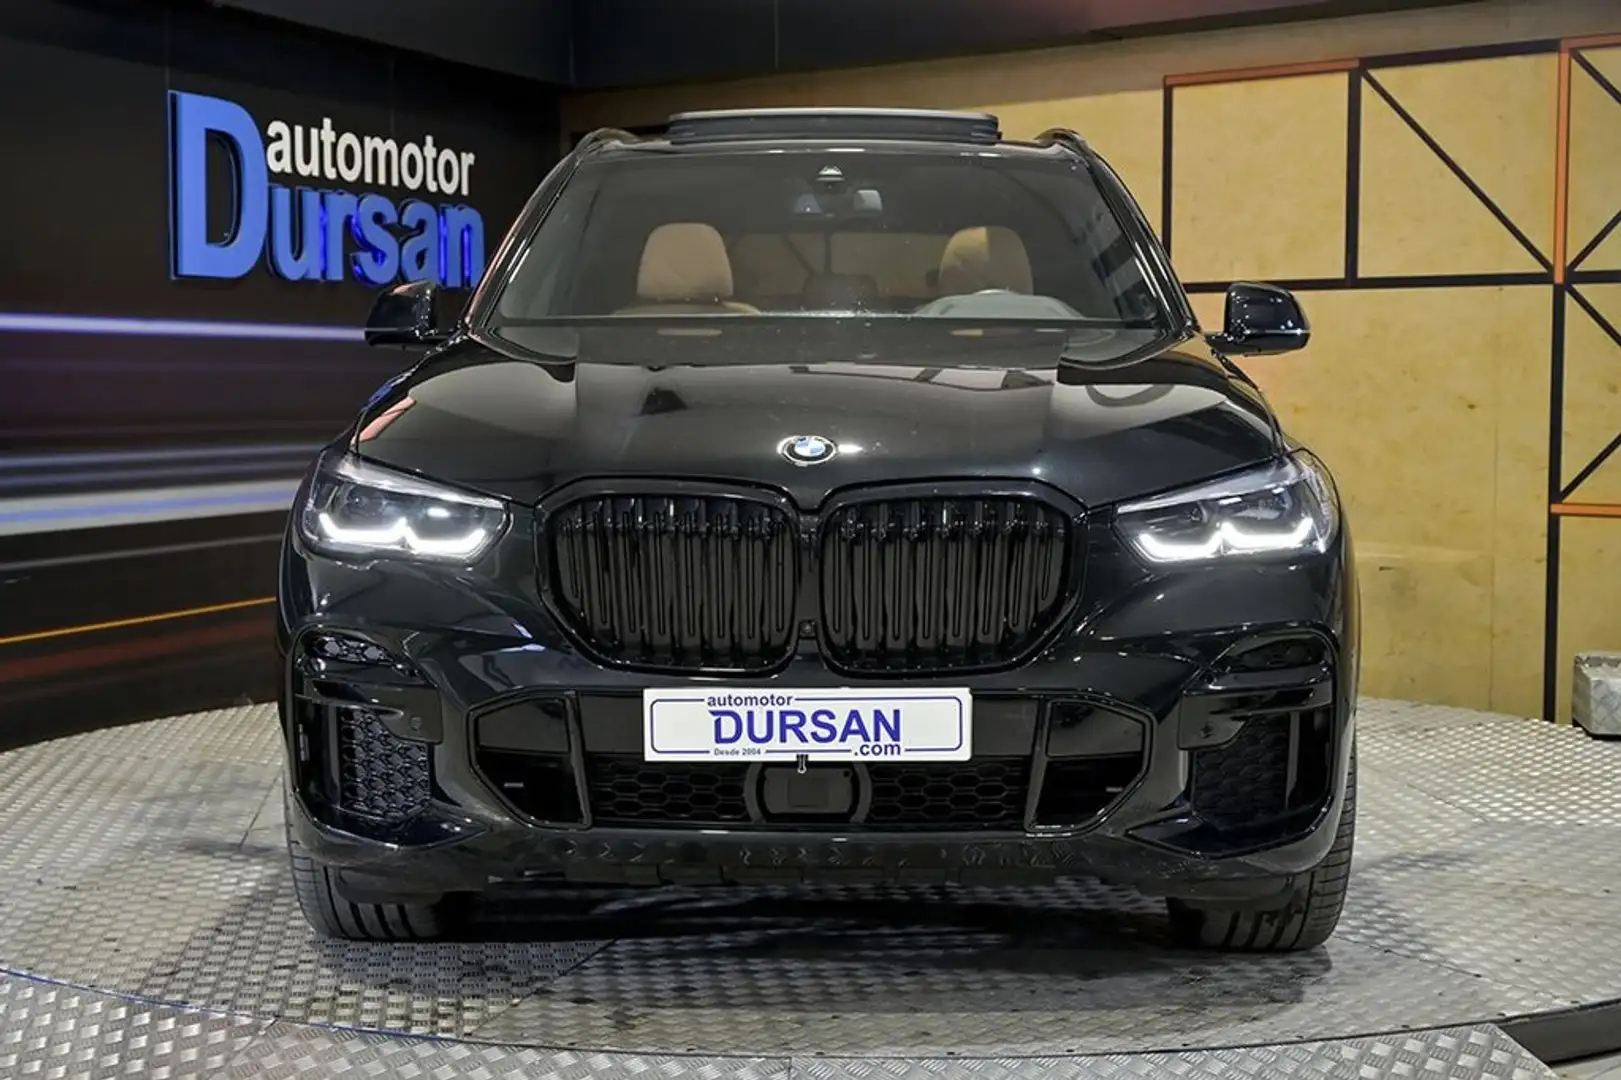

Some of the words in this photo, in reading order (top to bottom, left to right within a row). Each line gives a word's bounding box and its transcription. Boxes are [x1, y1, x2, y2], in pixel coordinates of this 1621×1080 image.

[266, 117, 476, 196] automotor
[168, 89, 486, 289] Dursan
[707, 694, 793, 707] automotor
[709, 709, 901, 744] DURSAN
[714, 748, 739, 756] Desde
[854, 742, 901, 757] .com
